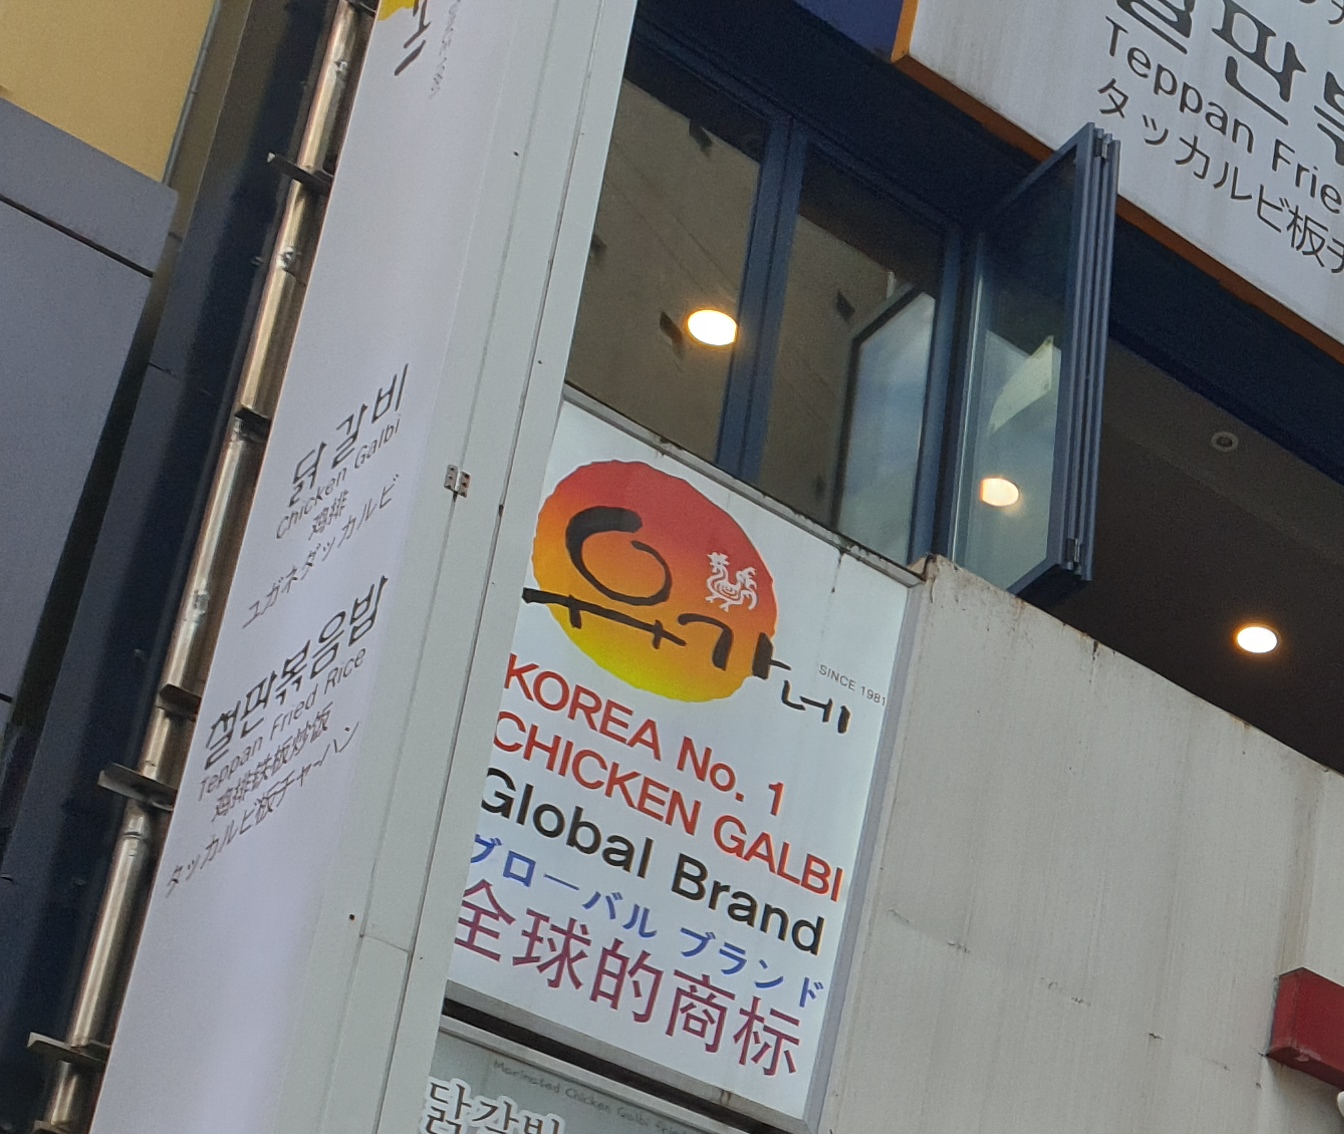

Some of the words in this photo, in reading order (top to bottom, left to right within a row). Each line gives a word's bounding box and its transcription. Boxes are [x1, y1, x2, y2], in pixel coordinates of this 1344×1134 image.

[1103, 16, 1255, 155] Teppan
[276, 467, 348, 540] Chicken
[353, 412, 403, 470] Galbi
[289, 363, 409, 508] 닭갈비
[203, 575, 389, 771] 철판볶음밥
[521, 506, 850, 734] 유가네
[818, 664, 857, 692] SINCE
[859, 684, 887, 708] 1981
[198, 735, 264, 802] Teppan
[269, 683, 320, 741] Fried
[323, 647, 368, 696] Rice
[503, 652, 662, 762] KOREA
[677, 736, 746, 803] No.
[768, 781, 786, 817] 1
[480, 767, 655, 880] Global
[671, 853, 826, 957] Brand
[491, 710, 702, 837] CHICKEN
[713, 814, 845, 904] GALBI
[454, 878, 801, 1078] 全球的商标
[680, 926, 826, 1009] ブランド
